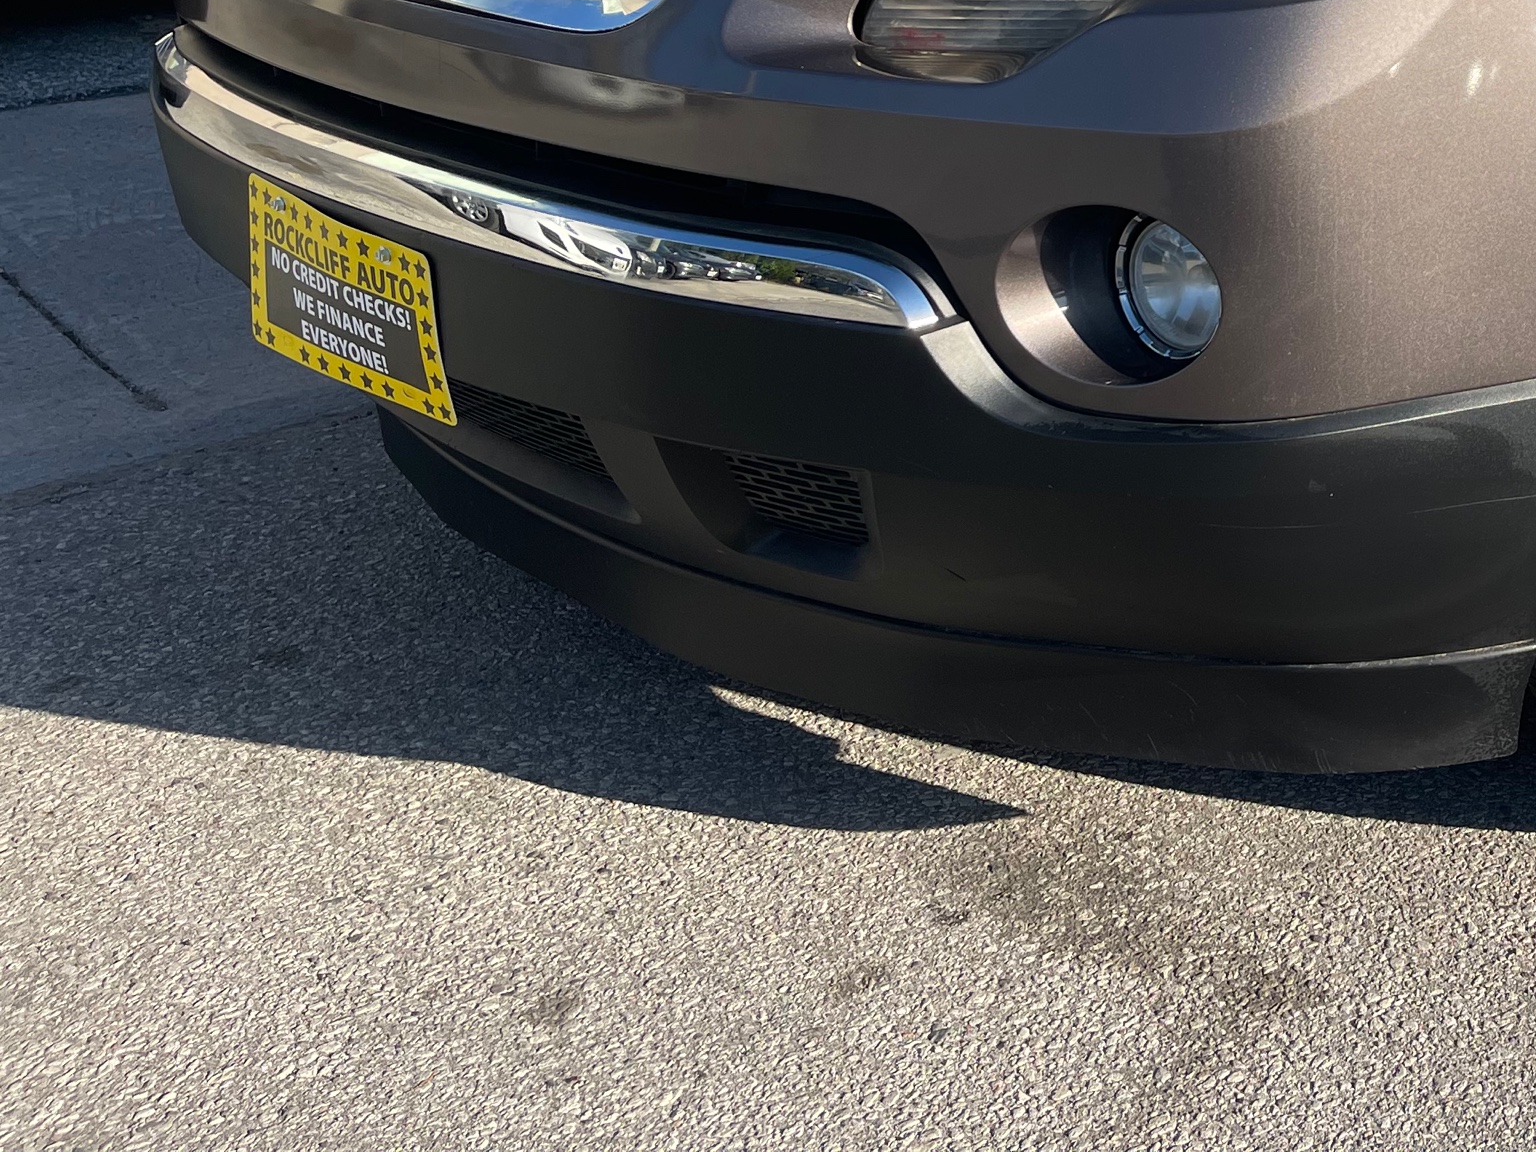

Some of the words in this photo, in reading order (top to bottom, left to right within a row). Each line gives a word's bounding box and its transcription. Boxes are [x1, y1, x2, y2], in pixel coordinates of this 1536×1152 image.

[263, 211, 351, 280] ROCKCLIFF
[357, 260, 415, 306] AUTO
[271, 246, 290, 274] NO
[292, 259, 340, 300] CREDIT
[342, 284, 412, 331] CHECKS!
[292, 286, 316, 317] WE
[317, 303, 386, 348] FINANCE
[301, 319, 389, 375] EVERYONE!
